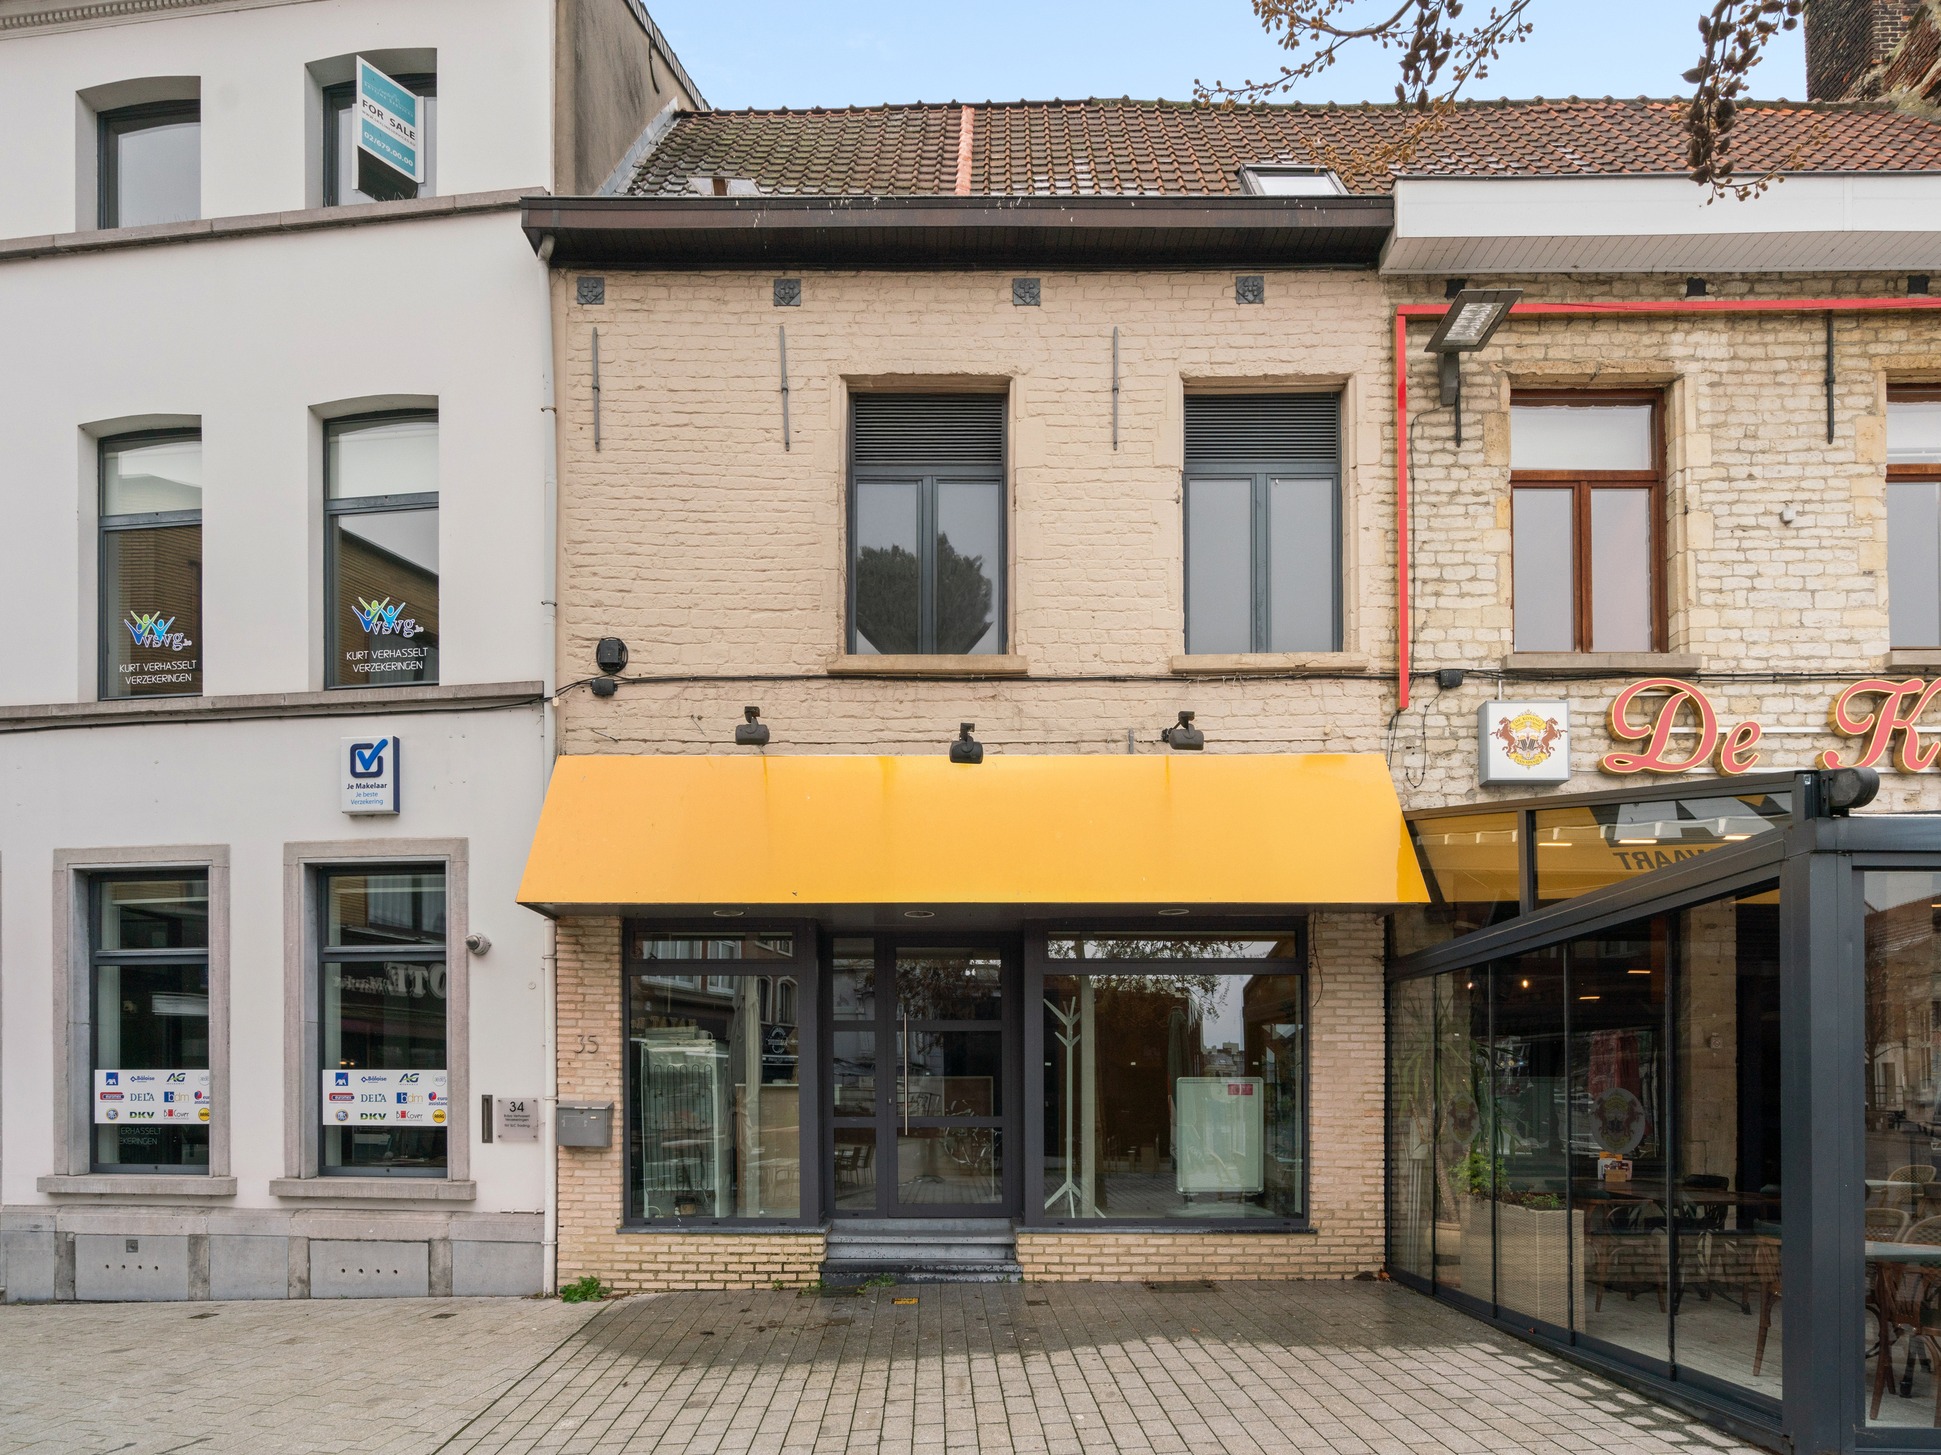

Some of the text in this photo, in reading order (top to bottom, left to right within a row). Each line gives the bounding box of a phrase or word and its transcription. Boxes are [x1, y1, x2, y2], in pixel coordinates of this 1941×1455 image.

[362, 99, 416, 141] FOR SALE
[363, 131, 414, 167] 02/679.00.00
[346, 647, 428, 661] KURT VERHASSELT
[119, 660, 197, 673] KURT VERHASSELT
[352, 660, 423, 673] VERZEKERINGEN
[125, 673, 192, 685] VERZEKERINGEN
[1597, 677, 1763, 778] De
[355, 782, 387, 790] Makelaar
[573, 1034, 600, 1054] 35
[166, 1072, 186, 1083] AG
[399, 1072, 420, 1083] AG
[130, 1092, 155, 1102] DELA
[361, 1093, 387, 1103] DELA
[509, 1101, 524, 1113] 34
[129, 1111, 155, 1119] DKV
[360, 1112, 387, 1120] DKV
